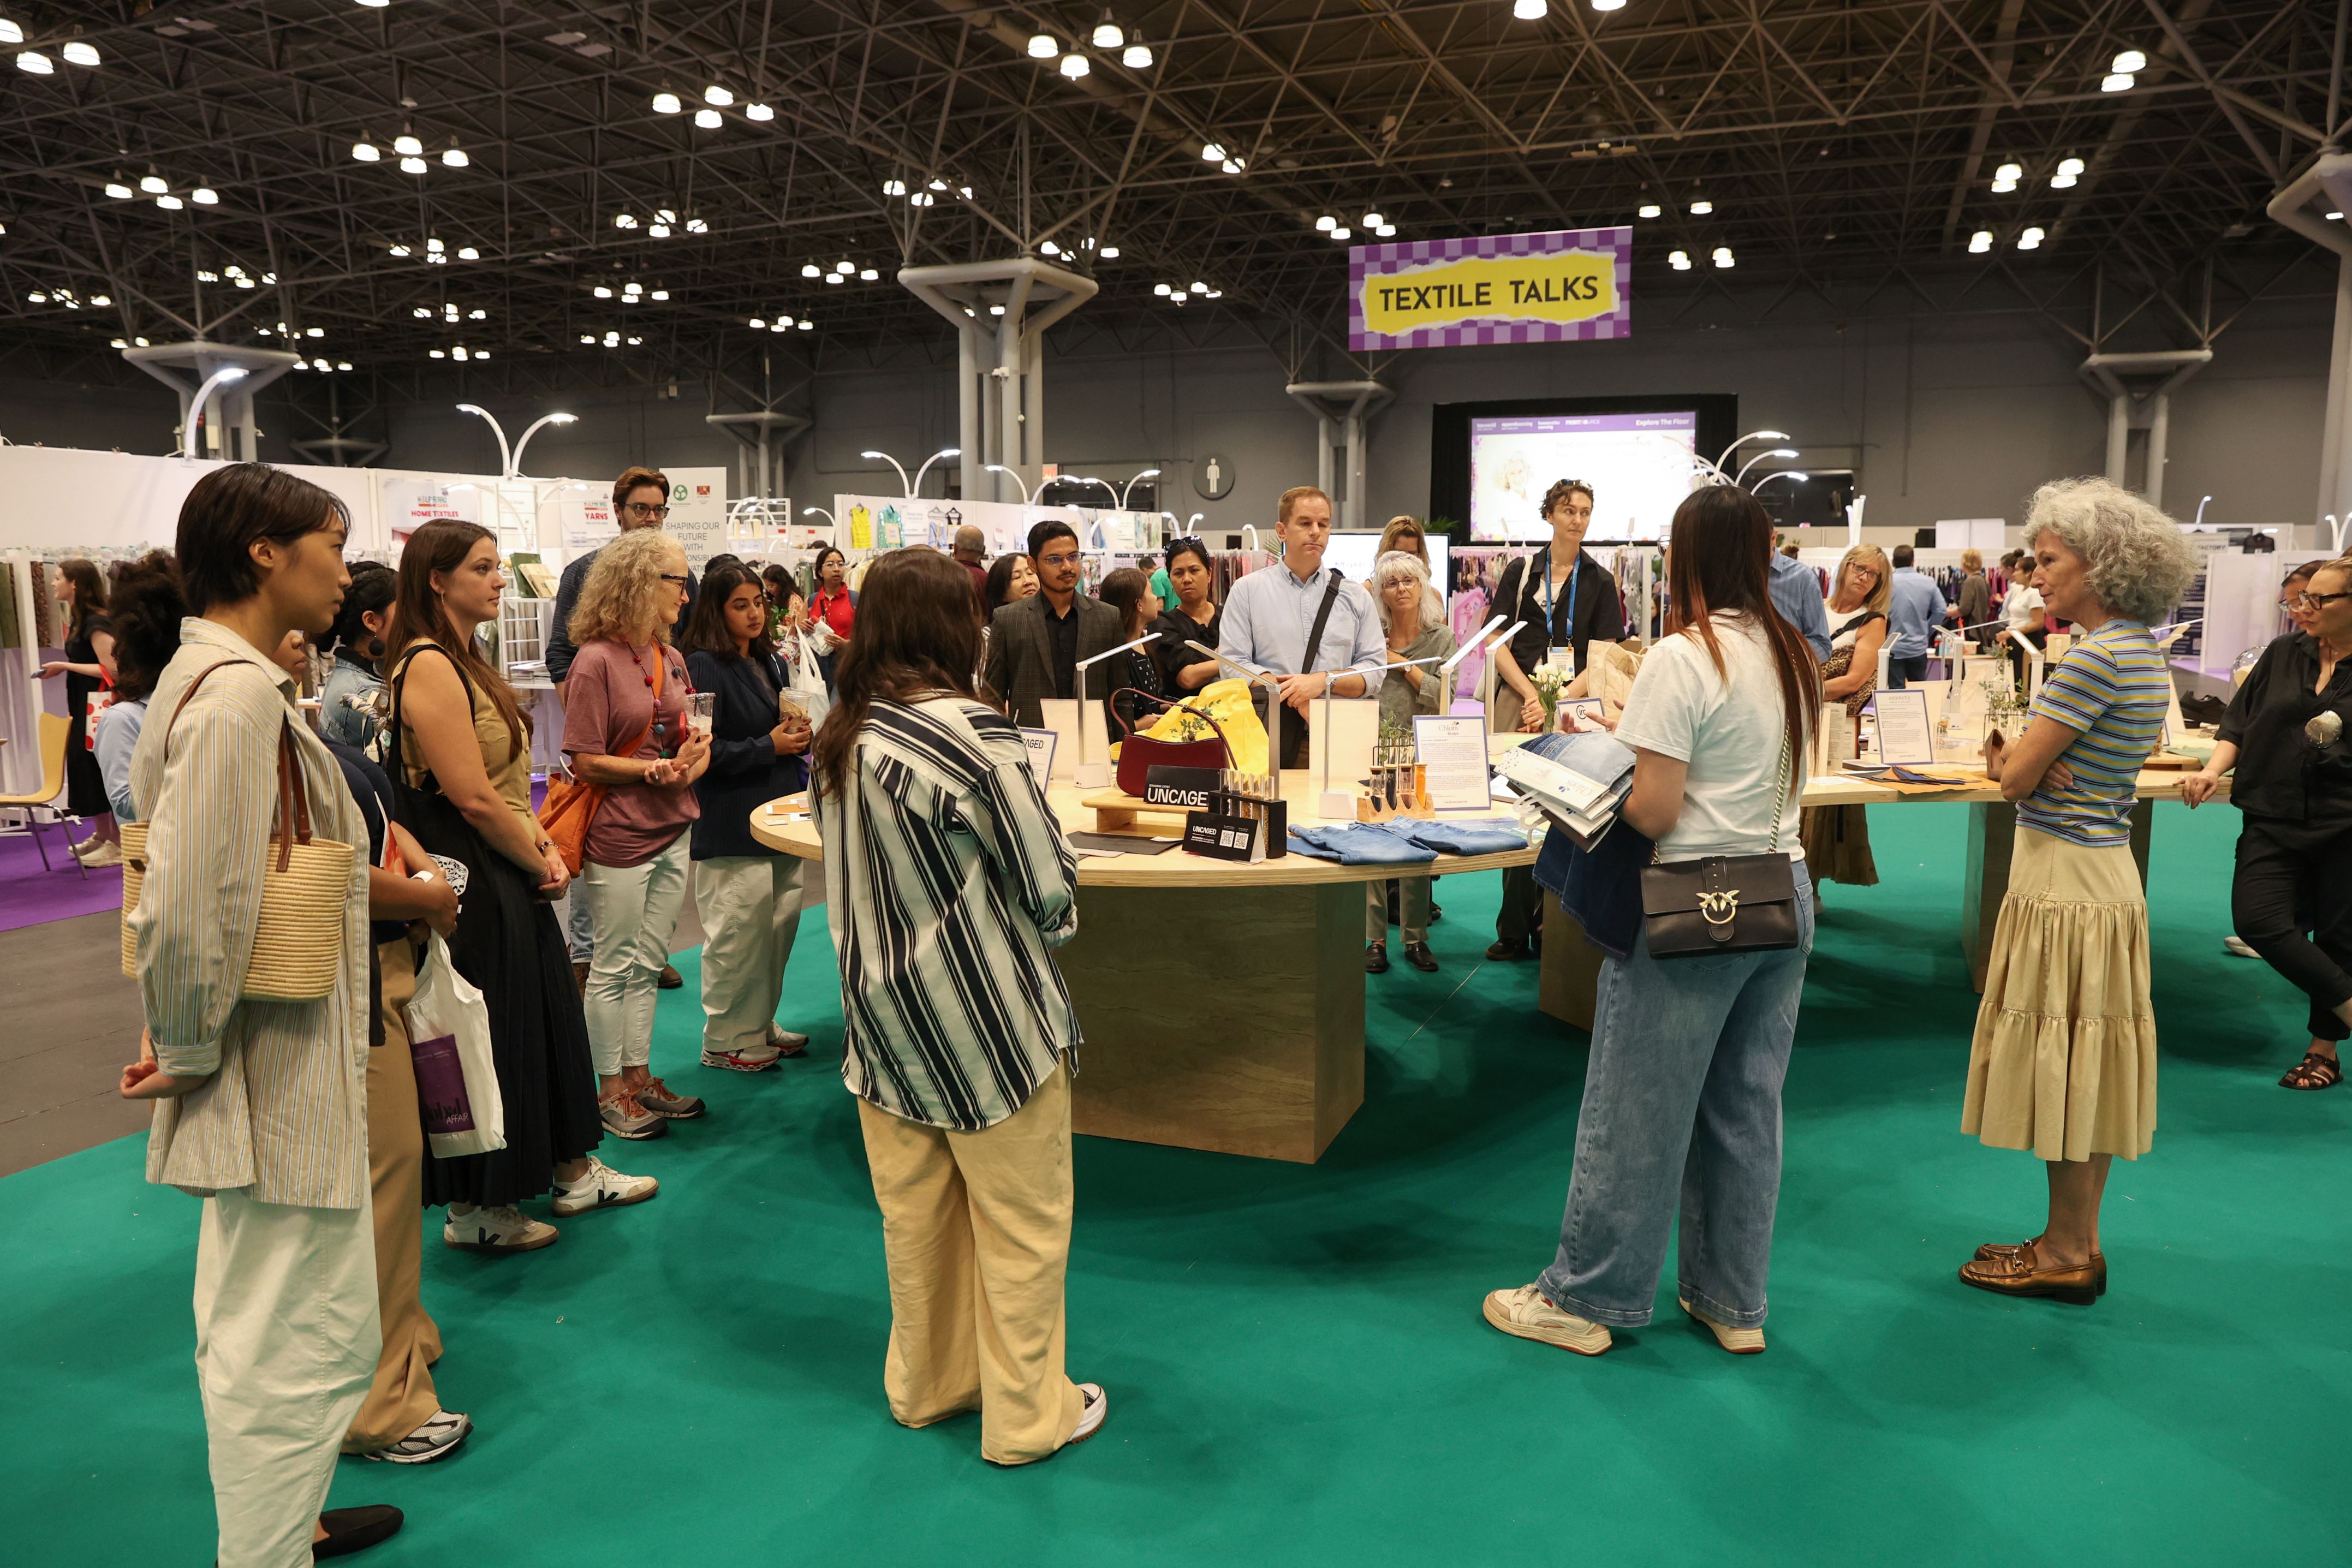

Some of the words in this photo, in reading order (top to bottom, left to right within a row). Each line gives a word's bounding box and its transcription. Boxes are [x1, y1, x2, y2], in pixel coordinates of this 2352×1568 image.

[1379, 282, 1492, 311] TEXTILE
[1509, 276, 1598, 303] TALKS
[665, 522, 701, 530] SHAPING
[1147, 788, 1209, 806] UNCAGE
[1192, 825, 1217, 835] UNCAGED
[446, 1112, 468, 1125] AFFAIR
